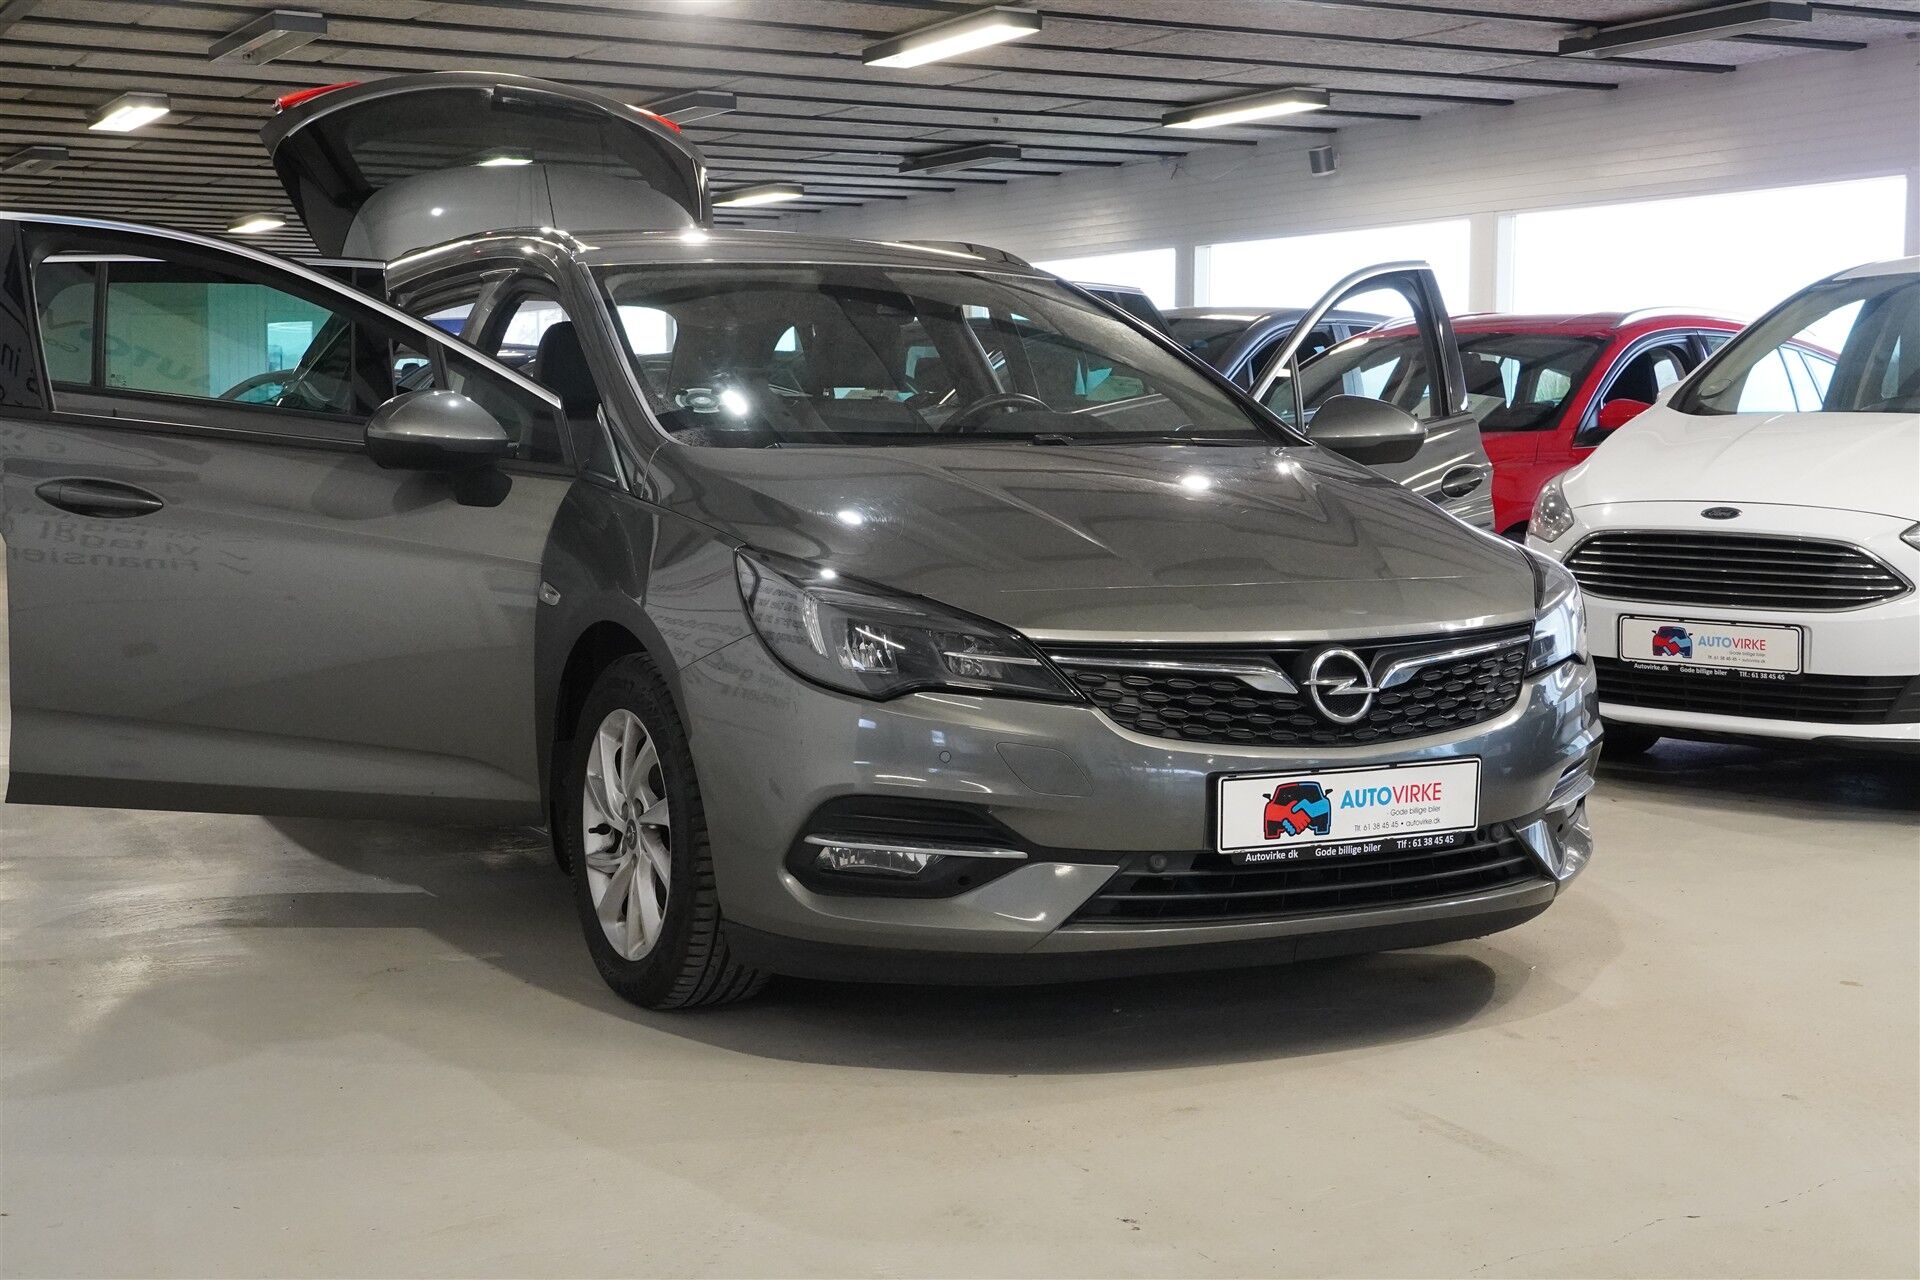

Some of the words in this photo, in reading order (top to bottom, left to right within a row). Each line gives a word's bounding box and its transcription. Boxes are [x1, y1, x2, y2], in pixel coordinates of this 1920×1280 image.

[1698, 635, 1766, 650] AUTOVIRKE
[1696, 668, 1713, 676] billige
[1340, 782, 1442, 809] AUTOVIRKE
[1409, 807, 1426, 815] billige
[1373, 822, 1380, 830] 38
[1382, 821, 1389, 829] 45
[1412, 838, 1422, 847] 61
[1423, 838, 1432, 846] 38
[1434, 836, 1443, 844] 45
[1445, 835, 1454, 843] 45
[1316, 847, 1336, 856] Gode
[1338, 845, 1361, 855] billige
[1364, 844, 1381, 852] biler
